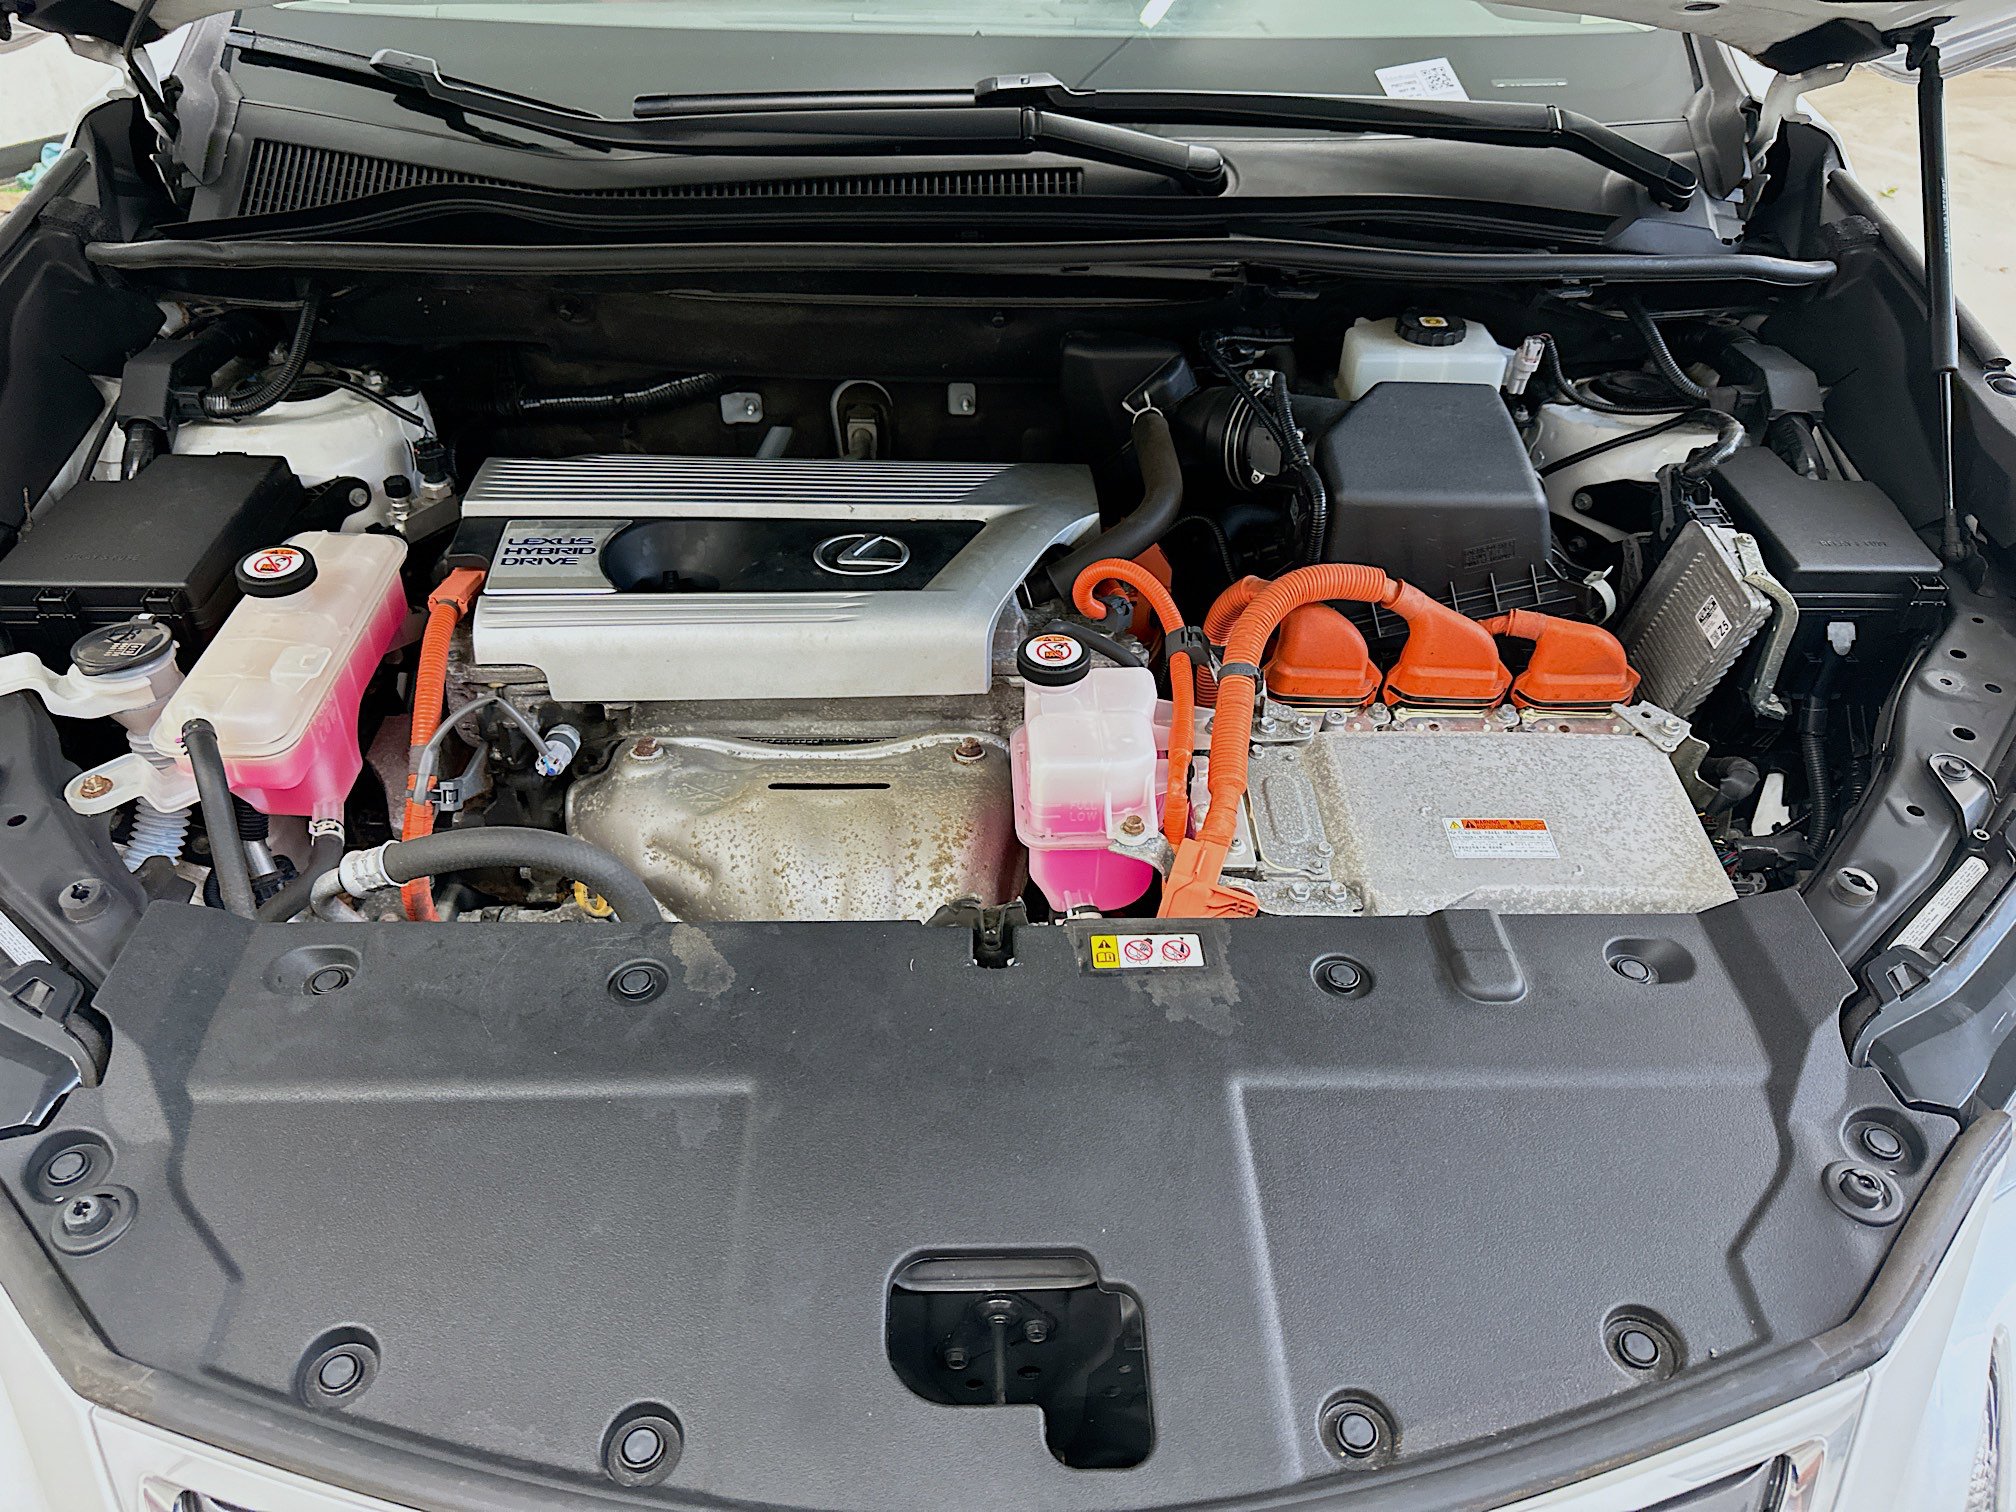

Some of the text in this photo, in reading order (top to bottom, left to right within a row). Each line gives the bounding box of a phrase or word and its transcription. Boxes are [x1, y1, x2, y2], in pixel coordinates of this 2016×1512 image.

[508, 538, 594, 546] LEXUS
[504, 547, 597, 555] HYBRID
[501, 557, 579, 566] DRIVE
[1070, 812, 1097, 823] LOW
